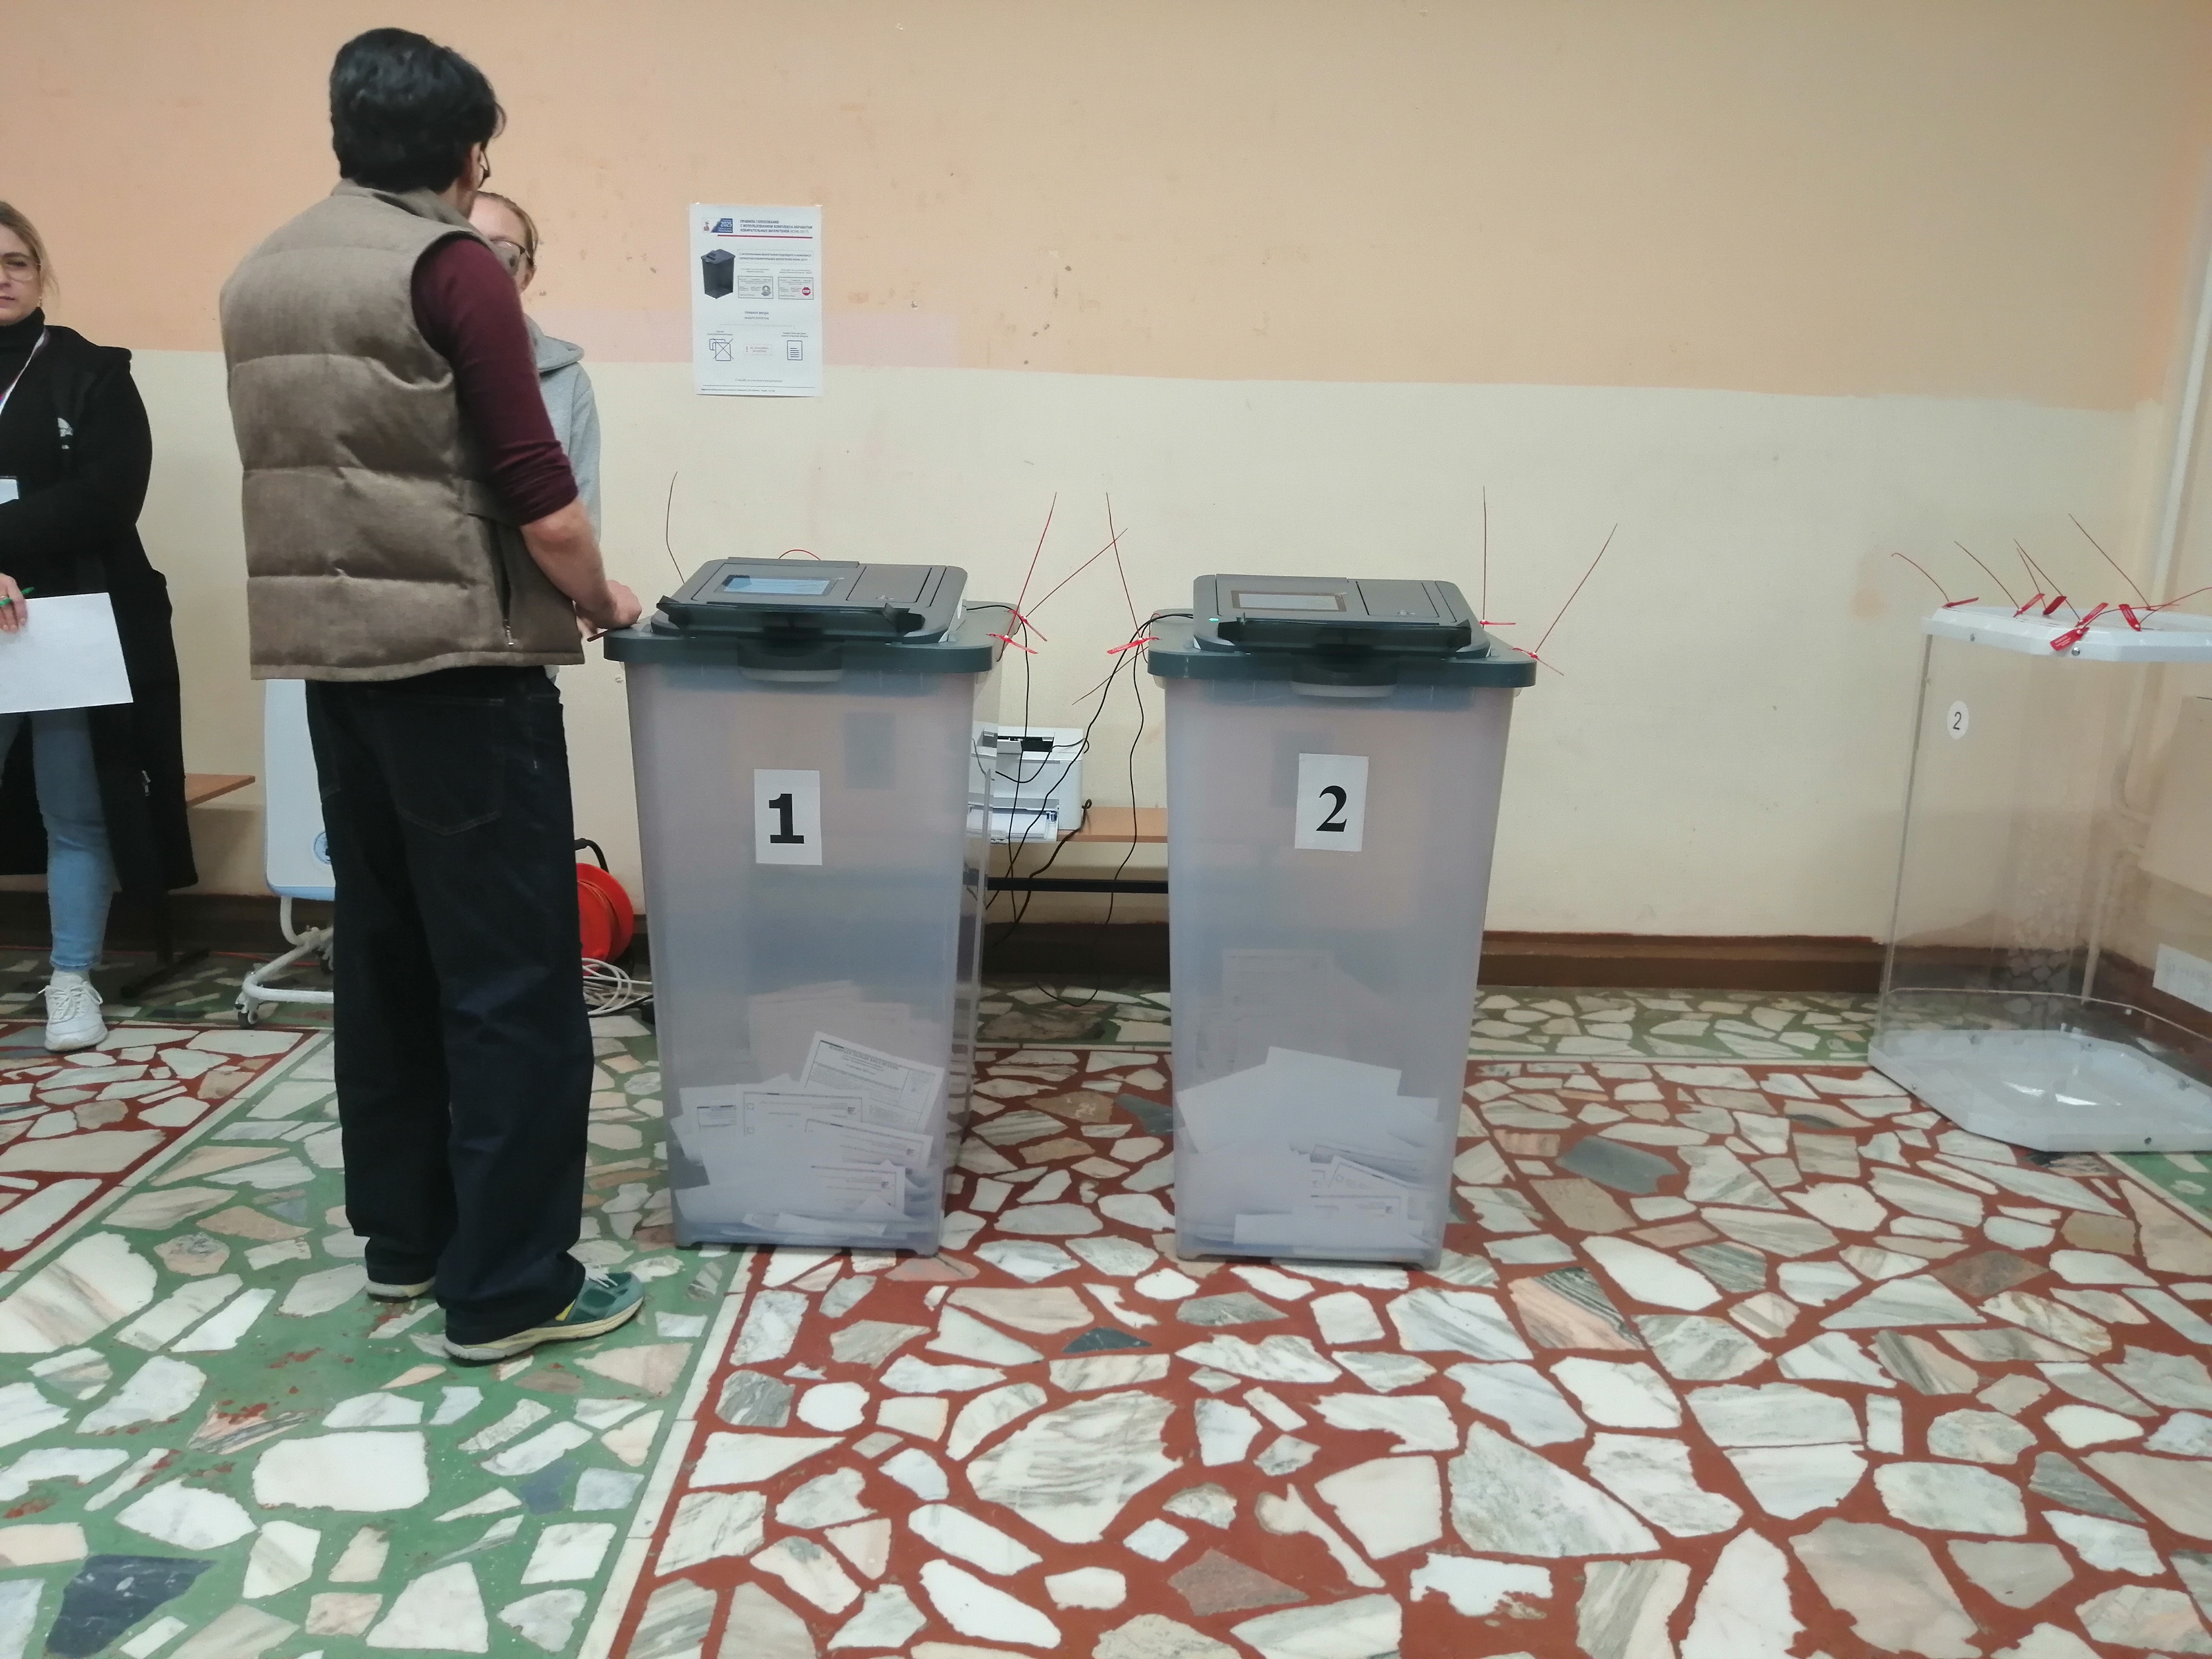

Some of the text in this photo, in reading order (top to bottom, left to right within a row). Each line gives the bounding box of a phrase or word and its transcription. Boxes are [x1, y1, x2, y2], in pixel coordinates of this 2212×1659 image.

[1952, 711, 1962, 730] 2
[768, 793, 805, 844] 1
[1316, 785, 1348, 832] 2
